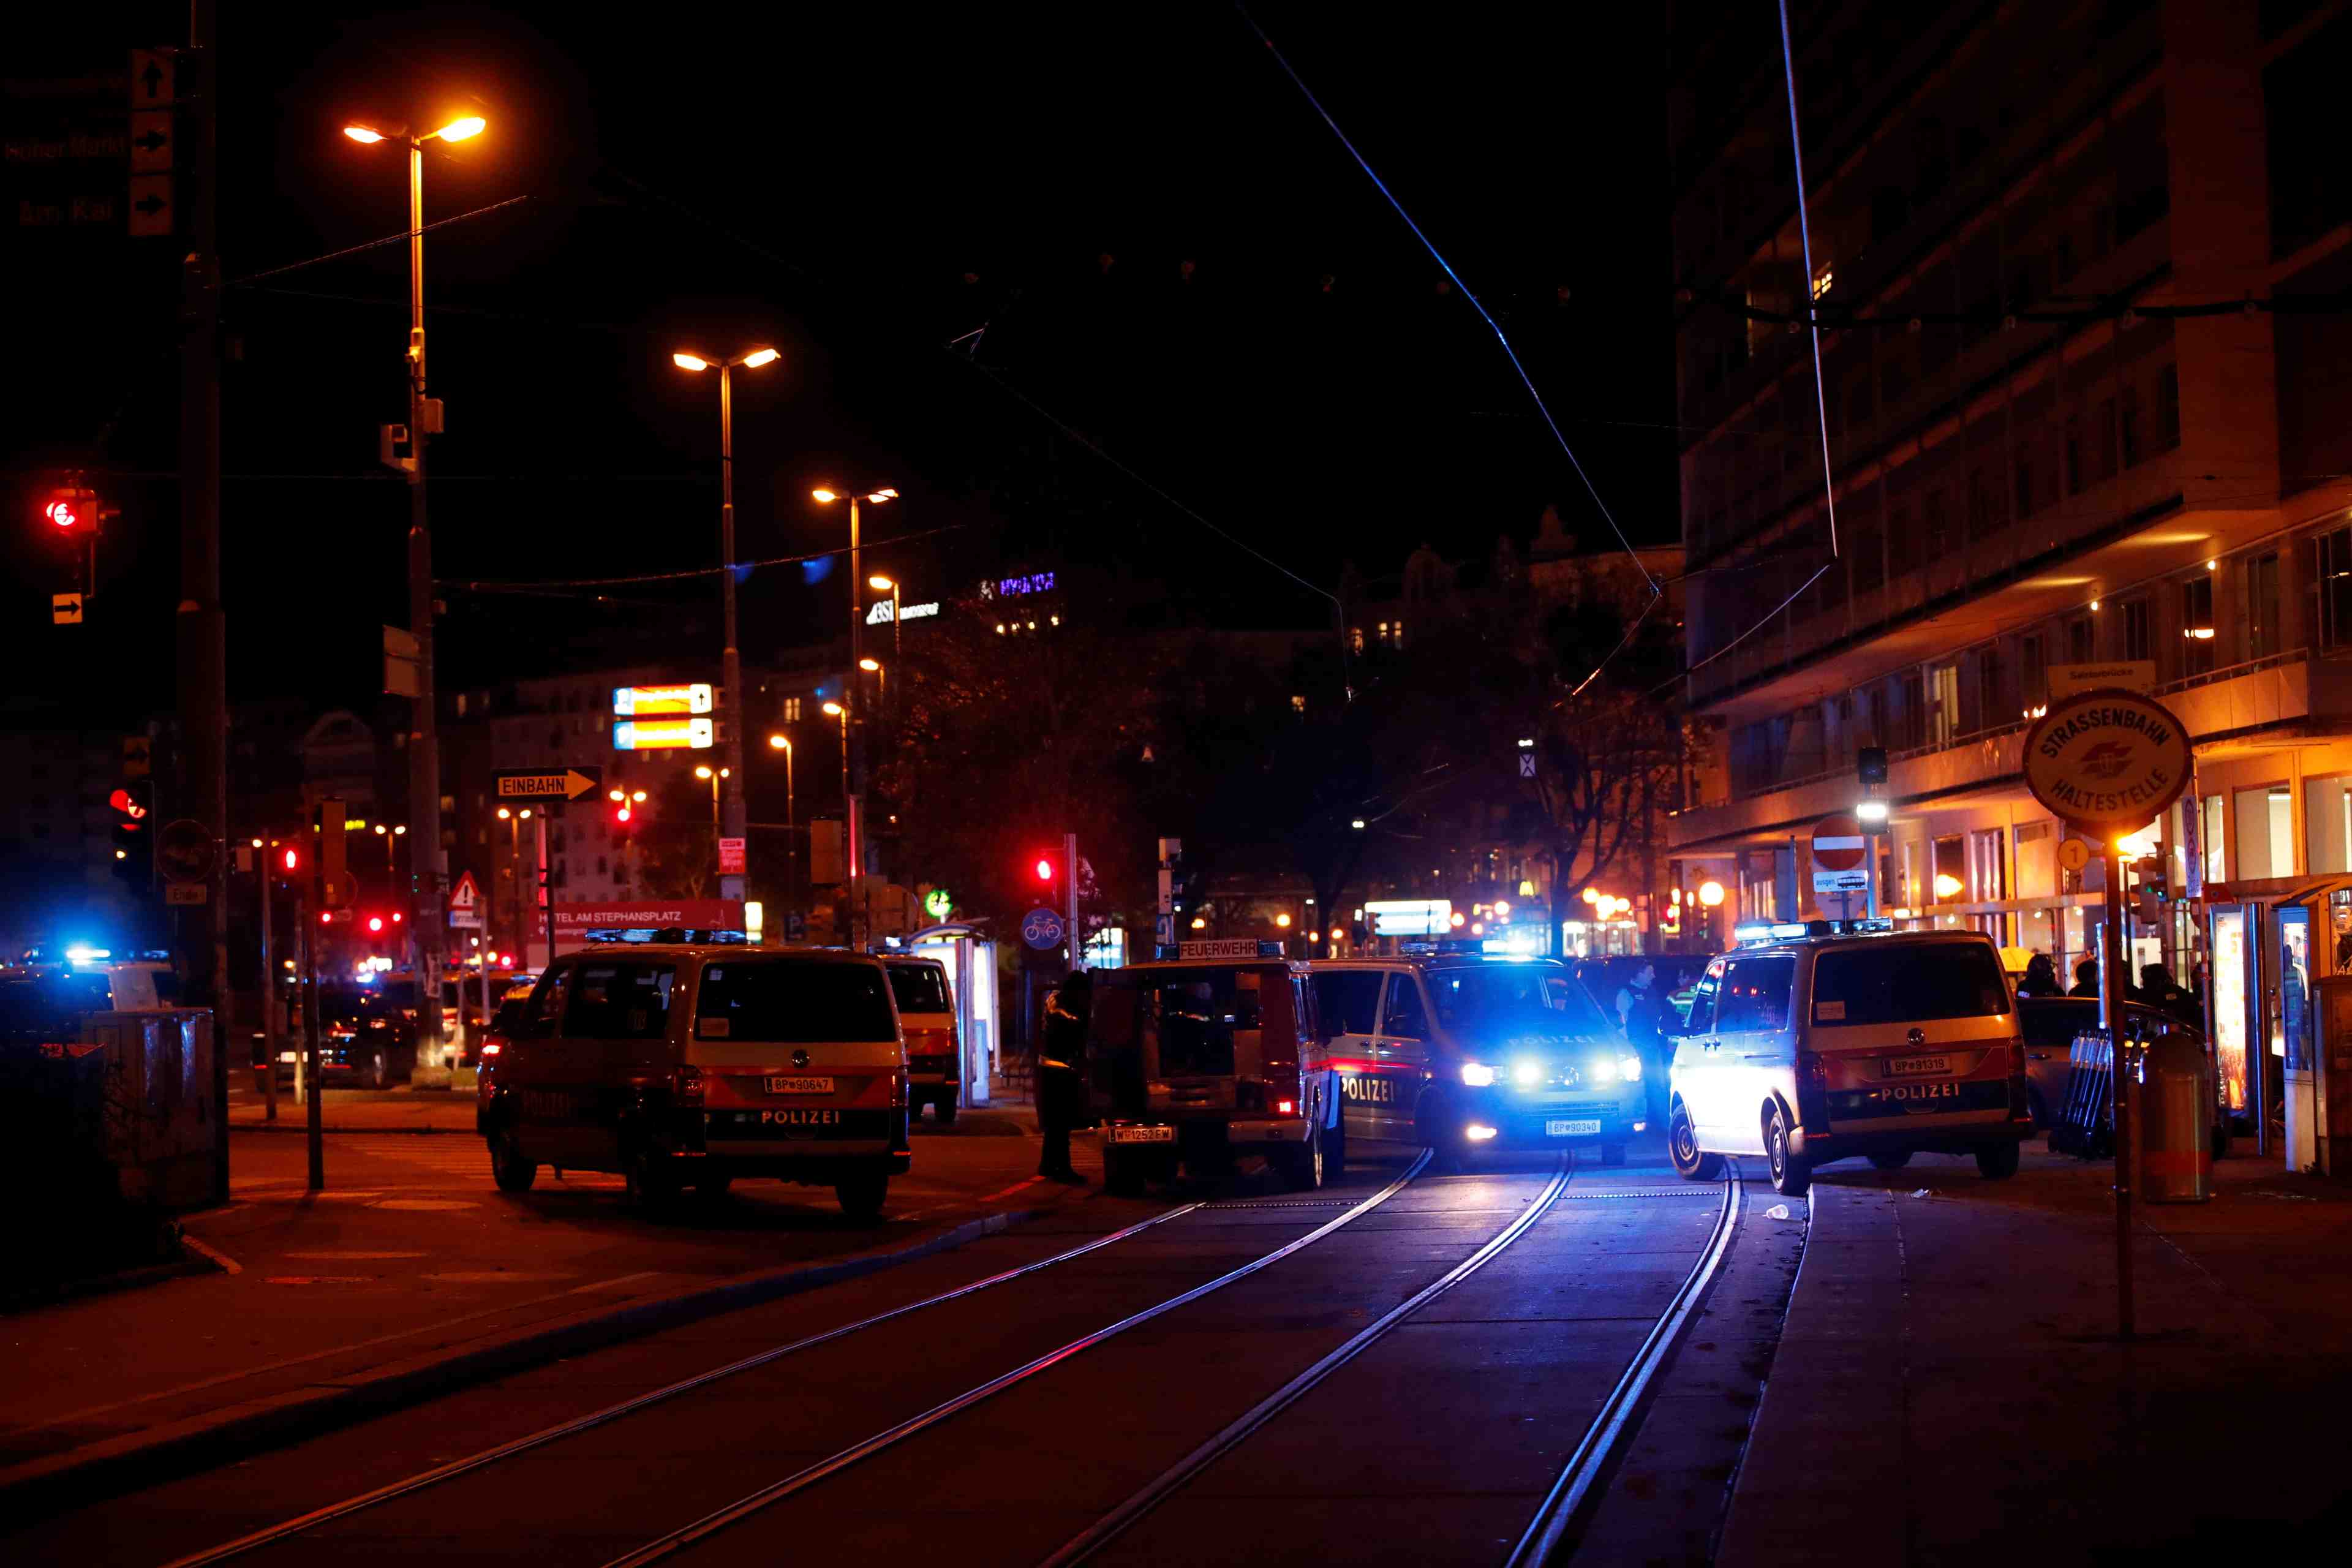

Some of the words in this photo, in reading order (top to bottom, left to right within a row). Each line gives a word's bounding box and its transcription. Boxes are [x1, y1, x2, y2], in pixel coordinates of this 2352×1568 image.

[2040, 708, 2171, 758] STRASSENBAHN
[503, 778, 565, 794] EINBAHN
[2051, 769, 2168, 812] HALTESTELLE
[2070, 846, 2078, 863] 1
[538, 913, 574, 923] HTEL
[576, 913, 592, 922] AM
[594, 911, 682, 922] STEPHANSPLATZ
[1180, 941, 1256, 956] FEUERWEHR
[1882, 1082, 1960, 1102] POLIZEI
[761, 1109, 840, 1125] POLIZEI
